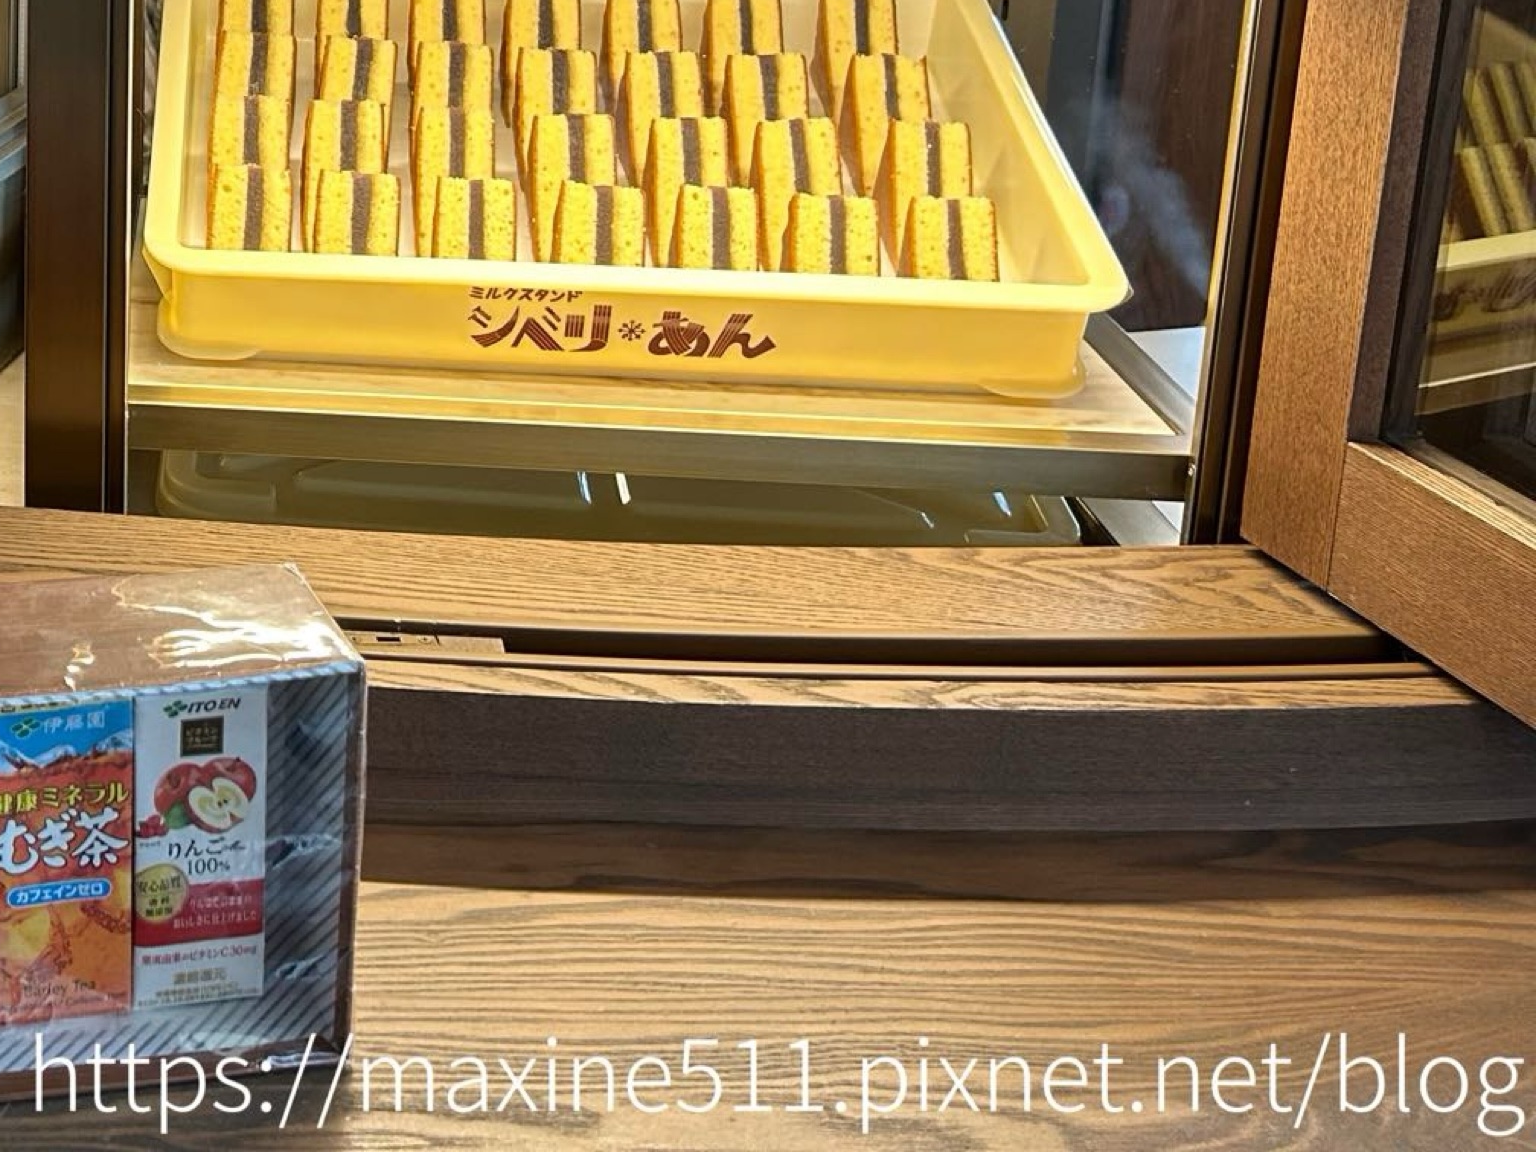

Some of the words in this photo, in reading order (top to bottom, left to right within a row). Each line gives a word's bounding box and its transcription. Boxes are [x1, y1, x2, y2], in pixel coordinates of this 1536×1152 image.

[469, 286, 583, 303] ミルクスタンド
[42, 711, 106, 734] 伊藤園
[168, 836, 226, 859] りんご
[188, 857, 231, 876] 100%
[16, 881, 104, 904] カフェインゼロ
